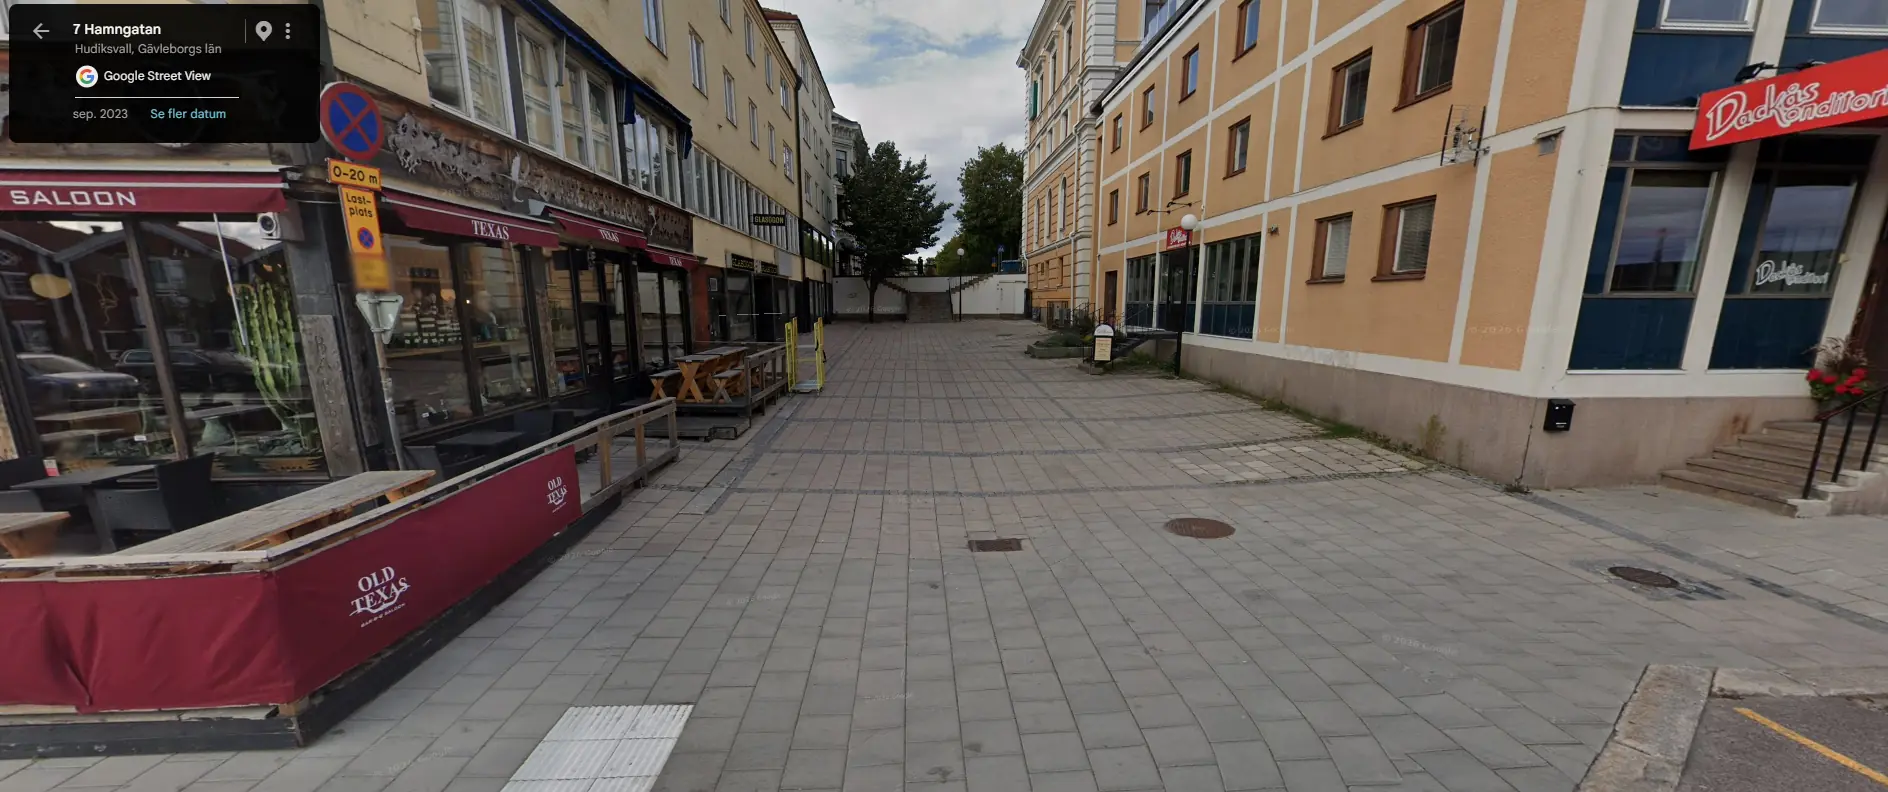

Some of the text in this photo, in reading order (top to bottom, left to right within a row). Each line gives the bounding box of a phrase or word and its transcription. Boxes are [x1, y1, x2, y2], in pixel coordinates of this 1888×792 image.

[1706, 82, 1820, 141] Dackås
[333, 166, 378, 184] 0-20 m
[11, 189, 137, 206] SALOON
[346, 192, 371, 204] Last-
[349, 206, 373, 217] plats
[471, 220, 510, 240] TEXAS
[599, 229, 620, 242] TEXAS
[548, 476, 563, 492] OLD
[547, 485, 568, 506] TEXAS
[358, 566, 395, 592] OLD
[349, 577, 411, 616] TEXAS
